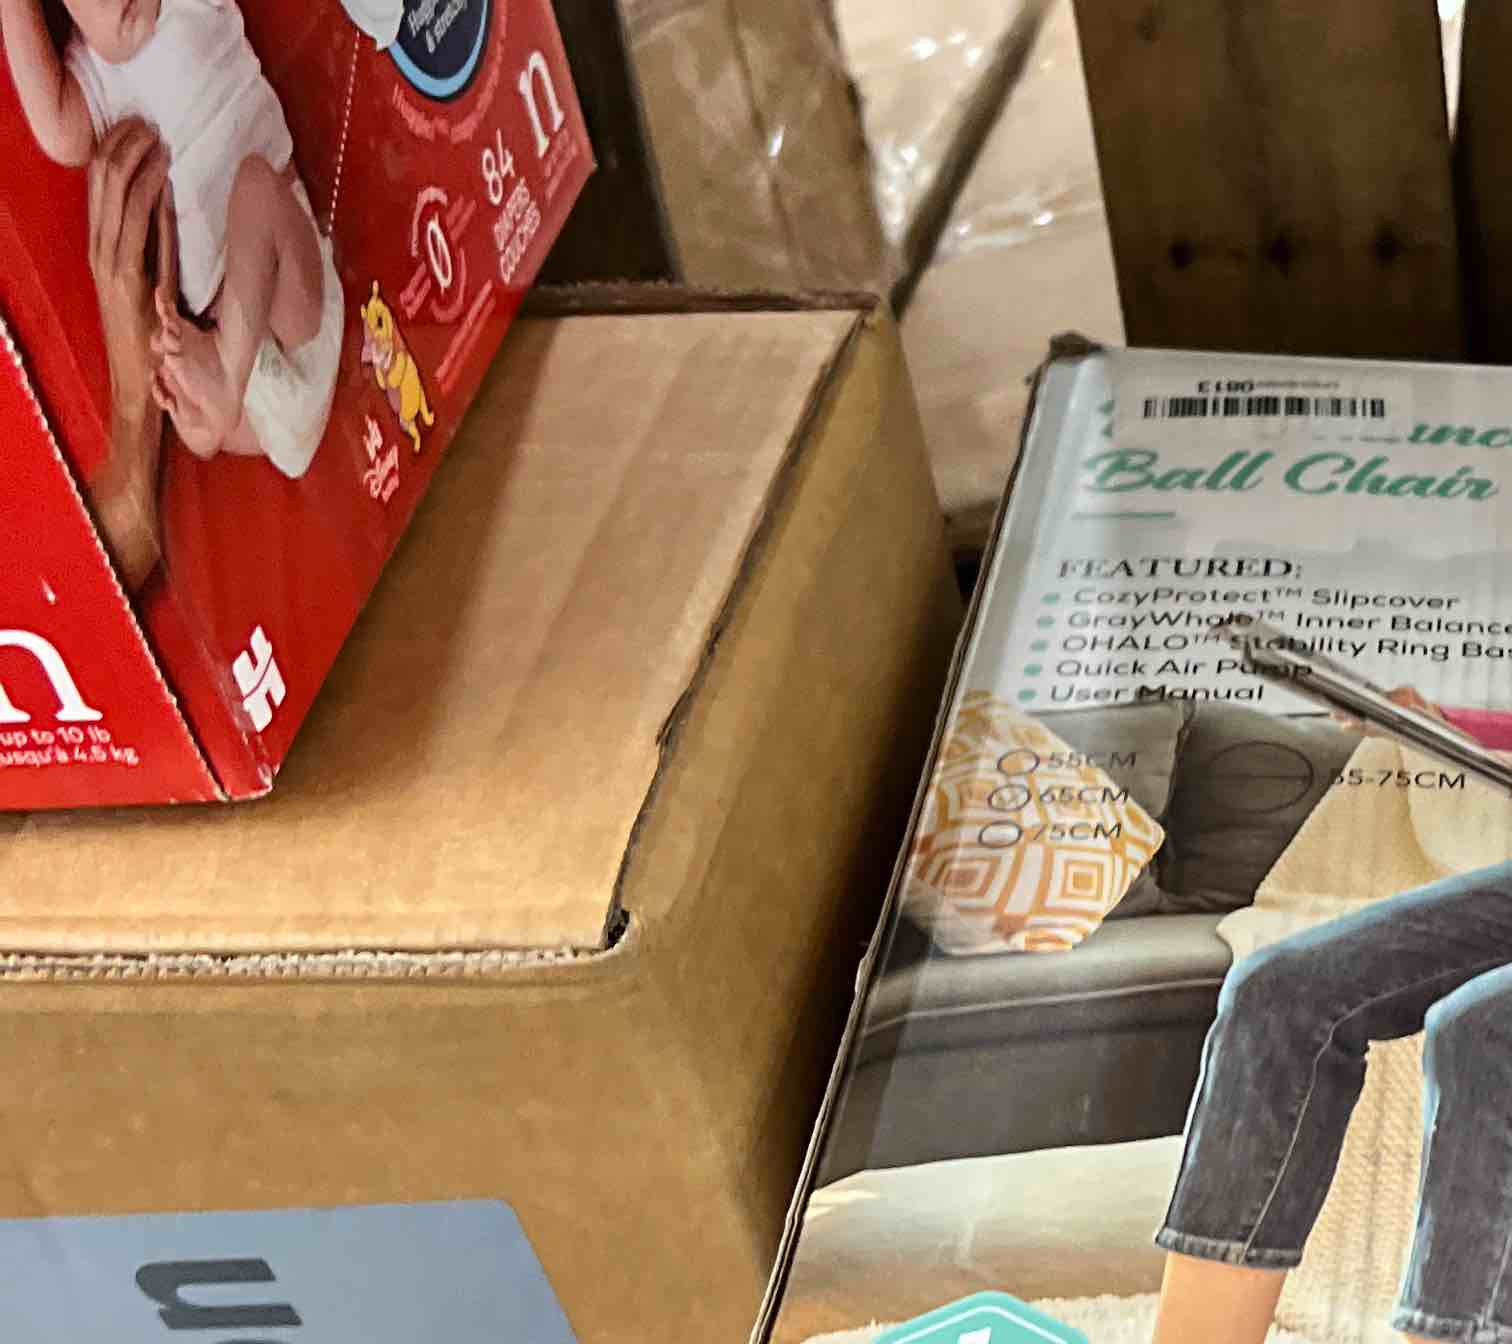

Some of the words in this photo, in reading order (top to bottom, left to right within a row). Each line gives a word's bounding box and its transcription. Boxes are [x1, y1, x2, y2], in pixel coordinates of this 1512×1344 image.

[518, 50, 566, 158] n
[481, 127, 516, 206] 84
[1083, 447, 1275, 493] Ball
[1283, 451, 1500, 501] Chair
[1058, 559, 1303, 579] FEATURED:
[1311, 587, 1461, 609] Slipcover
[1296, 613, 1382, 631] Inner
[1229, 634, 1368, 658] Stability
[1377, 637, 1450, 662] Ring
[1056, 658, 1146, 677] Quick
[1156, 658, 1207, 675] Air
[1050, 684, 1128, 702] User
[1136, 683, 1265, 702] Manual
[0, 731, 28, 748] up
[30, 727, 56, 745] to
[56, 725, 85, 745] 10
[87, 724, 112, 744] lb
[110, 742, 140, 766] kg
[1039, 786, 1130, 803] 65CM
[1033, 821, 1122, 840] 75CM
